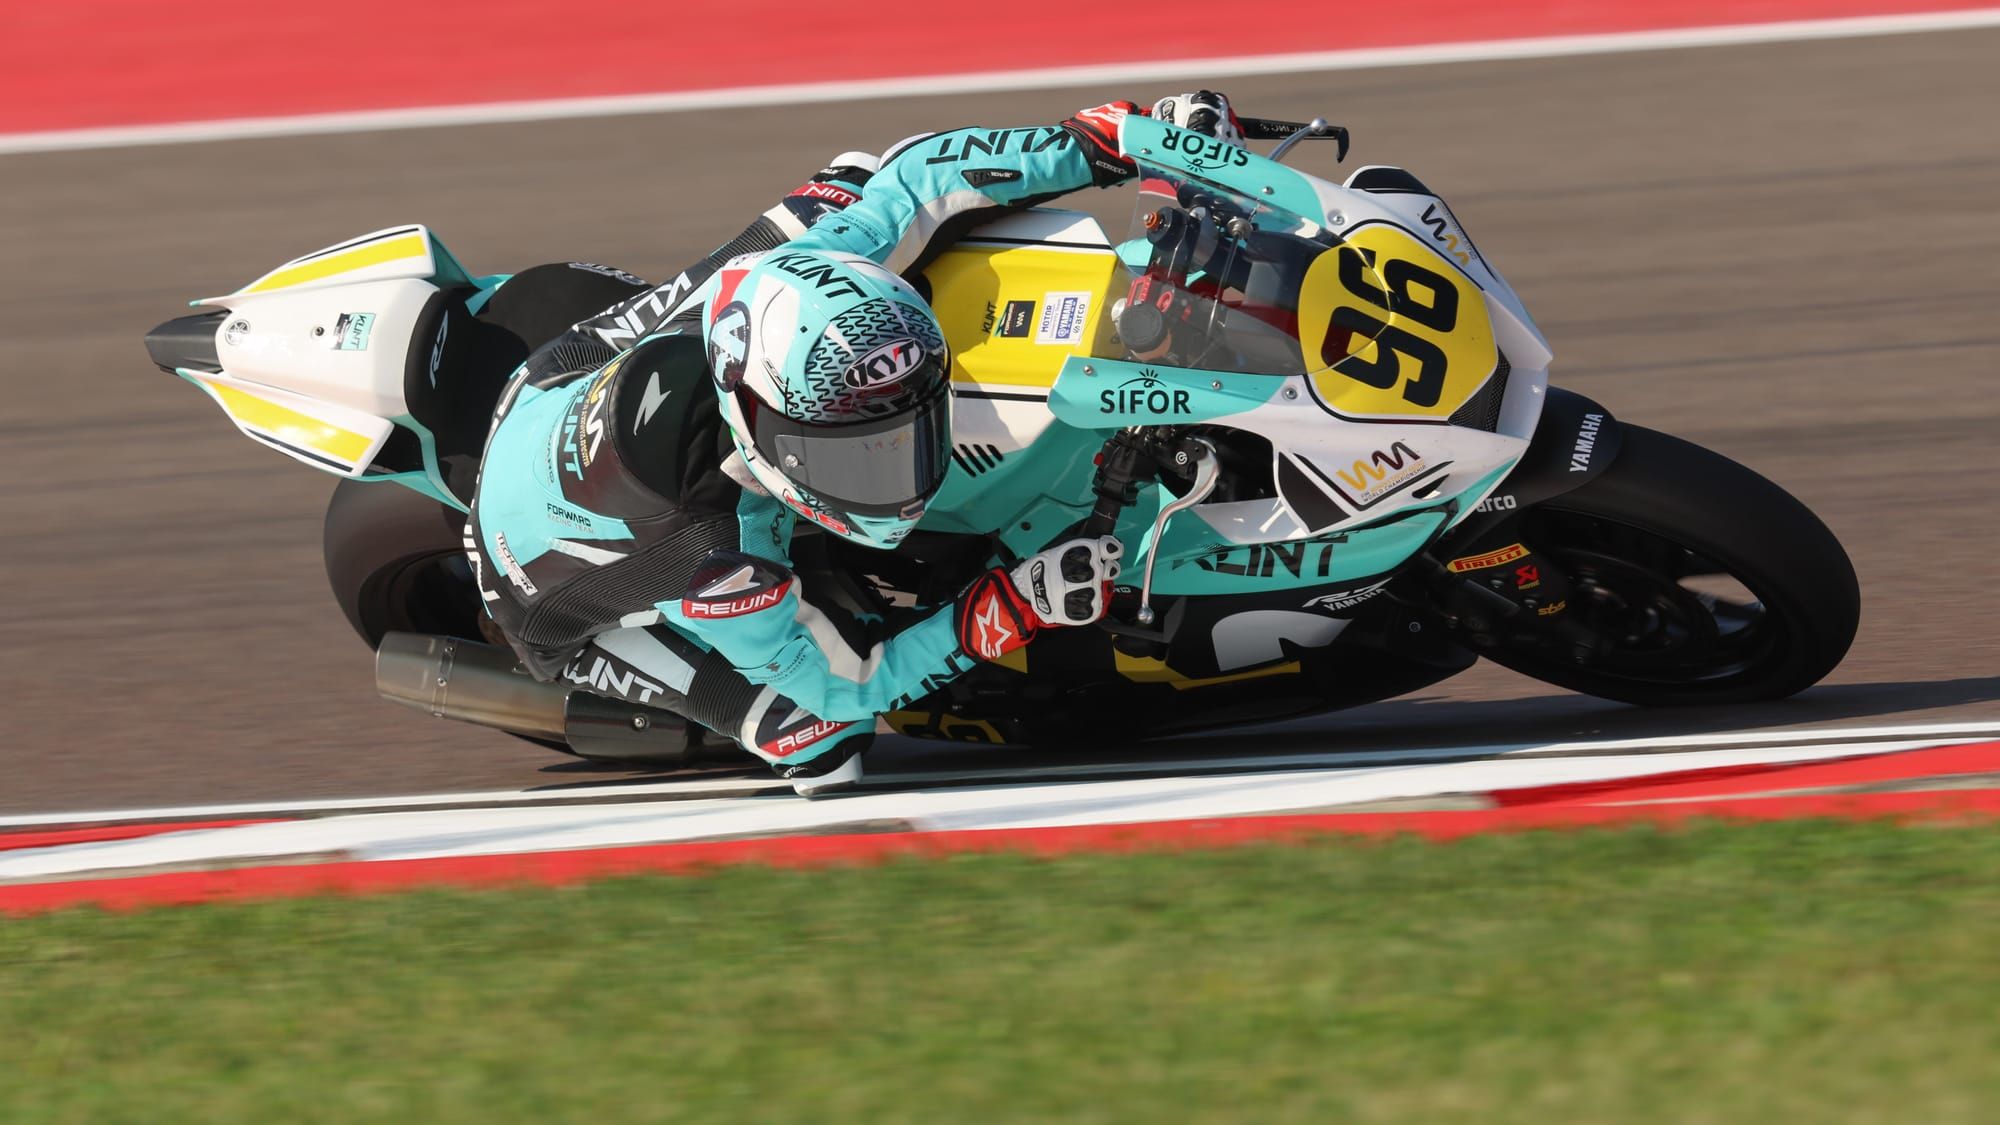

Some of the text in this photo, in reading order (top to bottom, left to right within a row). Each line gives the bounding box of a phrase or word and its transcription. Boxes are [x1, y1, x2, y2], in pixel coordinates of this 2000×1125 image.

[926, 127, 1073, 166] KLINT
[1162, 127, 1252, 167] SIFOR
[802, 185, 858, 205] WIN
[766, 252, 869, 300] KLINT
[981, 300, 997, 334] KLINT
[1060, 298, 1074, 330] YAMAHA
[1320, 246, 1460, 408] 96
[351, 314, 368, 349] KLINT
[848, 341, 917, 388] KYT
[1100, 389, 1192, 414] SIFOR
[1569, 413, 1604, 472] YAMAHA
[546, 502, 592, 528] FORWARD
[1454, 545, 1523, 572] PIRELLI
[691, 588, 779, 616] REWIN
[1324, 587, 1386, 612] YAMAHA
[777, 719, 842, 752] REW
